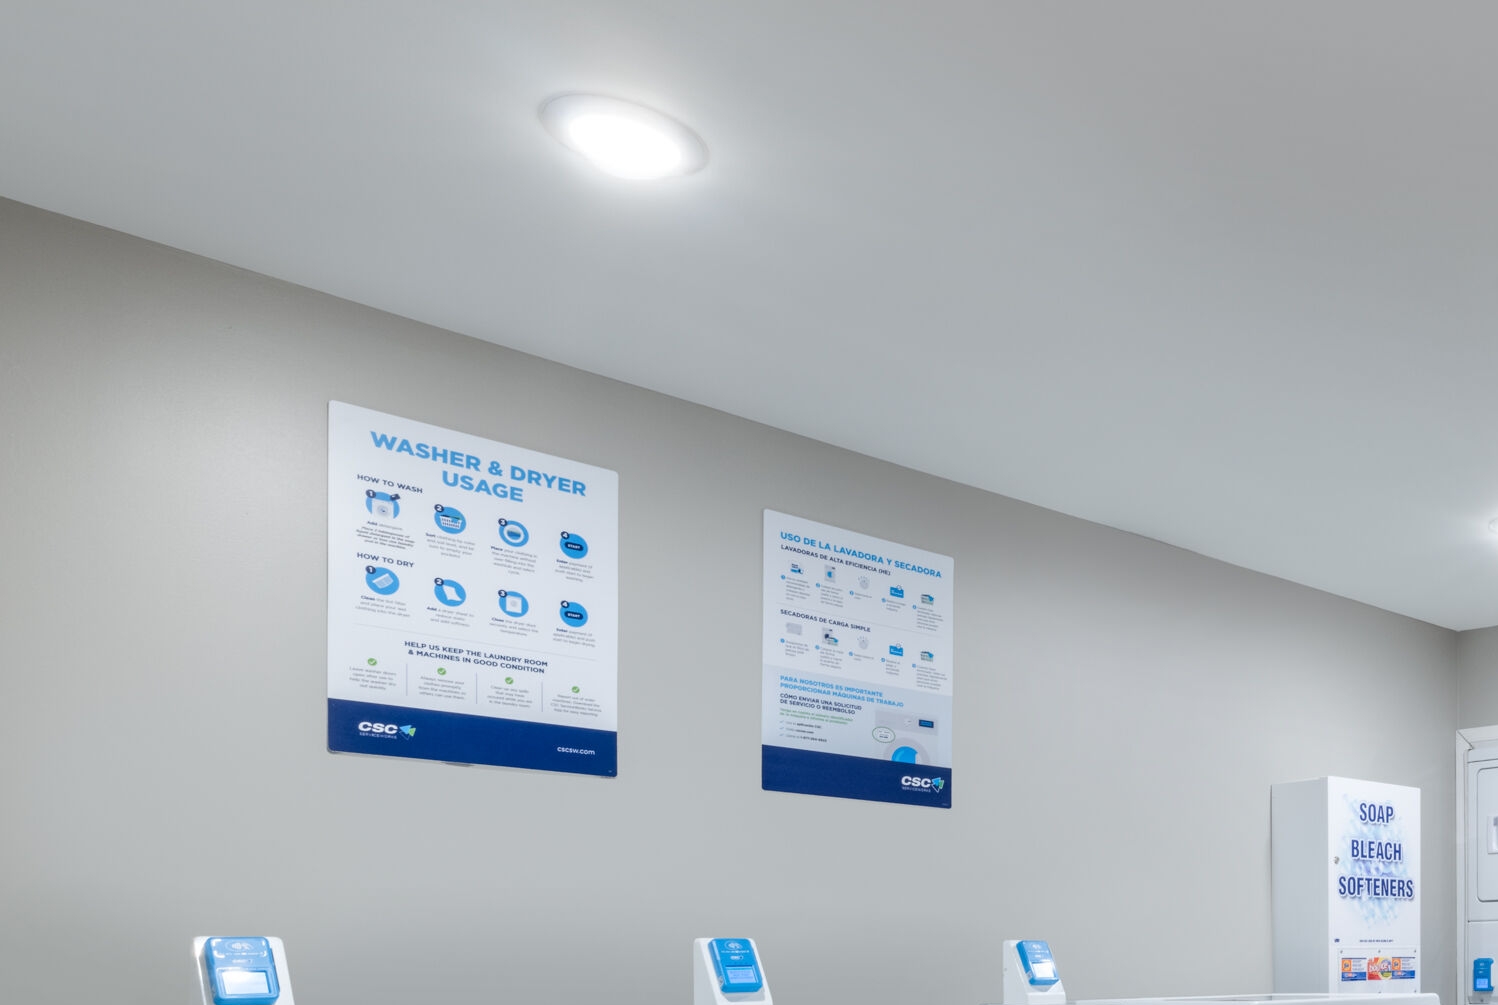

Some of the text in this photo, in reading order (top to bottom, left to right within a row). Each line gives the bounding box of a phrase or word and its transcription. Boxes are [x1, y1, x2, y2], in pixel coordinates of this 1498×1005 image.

[370, 431, 586, 496] WASHER & DRYER
[357, 474, 423, 494] HOW TO WASH
[442, 470, 524, 502] USAGE
[357, 552, 379, 561] HOW
[397, 560, 414, 568] DRY
[780, 532, 942, 578] USO DE LA LAVADORA Y SECADORA
[781, 544, 818, 558] LAVADORAS
[830, 556, 843, 564] ALTA
[845, 560, 877, 572] EFICIENCIA
[780, 609, 817, 622] SECADORAS
[828, 619, 848, 628] CARGA
[850, 623, 871, 632] SIMPLE
[416, 651, 460, 662] MACHINES
[473, 658, 498, 667] GOOD
[500, 662, 545, 674] CONDITION
[442, 646, 464, 654] KEEP
[484, 652, 522, 663] LAUNDRY
[524, 659, 548, 667] ROOM
[780, 683, 831, 695] PROPORCIONAR
[876, 698, 904, 707] TRABAJO
[800, 679, 833, 689] NOSOTROS
[845, 686, 883, 697] IMPORTANTE
[789, 700, 815, 709] SERVICIO
[822, 705, 856, 714] REEMBOLSO
[834, 701, 862, 711] SOLICITUD
[358, 721, 398, 734] CSC
[557, 746, 595, 756] cscsw.com
[901, 776, 931, 788] CSC
[1359, 802, 1394, 823] SOAP
[1351, 839, 1402, 861] BLEACH
[1339, 876, 1413, 897] SOFTENERS
